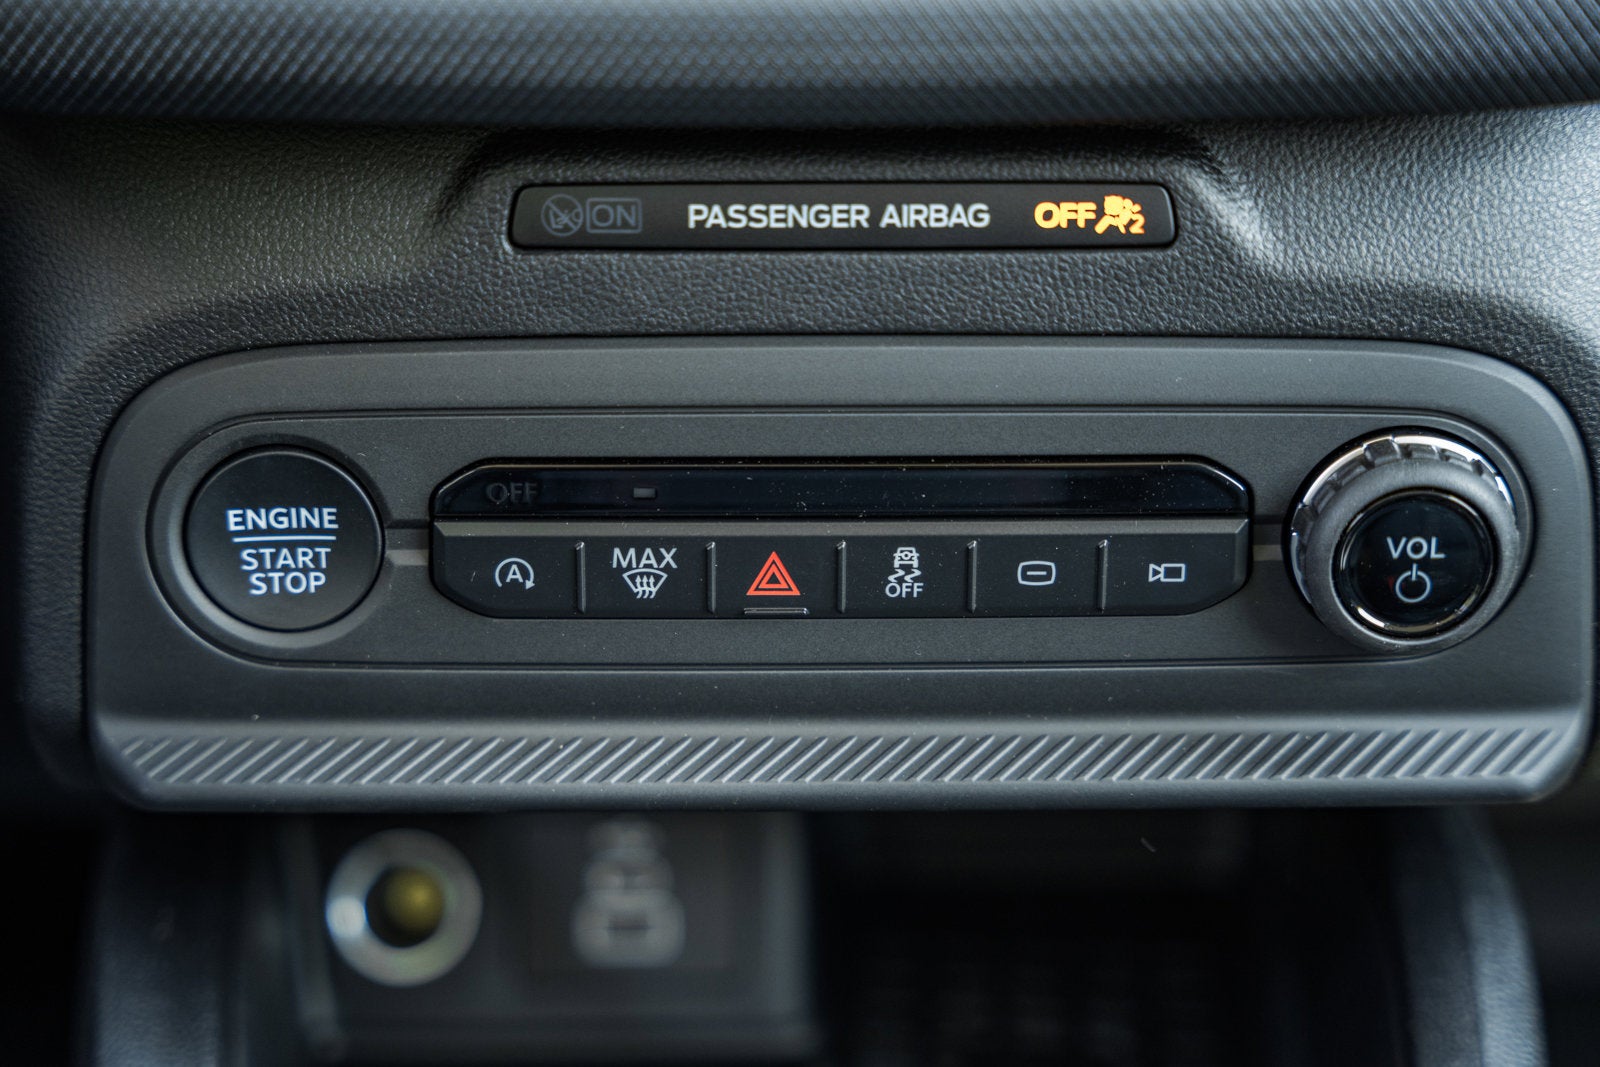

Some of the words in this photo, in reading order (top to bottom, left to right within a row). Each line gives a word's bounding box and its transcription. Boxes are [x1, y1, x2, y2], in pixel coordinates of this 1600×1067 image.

[591, 204, 637, 227] ON
[687, 203, 870, 229] PASSENGER
[880, 203, 991, 228] AIRBAG
[1034, 201, 1097, 229] OFF
[486, 482, 539, 503] OFF
[227, 507, 338, 531] ENGINE
[241, 548, 331, 570] START
[612, 547, 678, 568] MAX
[1386, 536, 1446, 559] VOL
[250, 572, 326, 595] STOP
[505, 564, 524, 583] A
[885, 582, 924, 598] OFF
